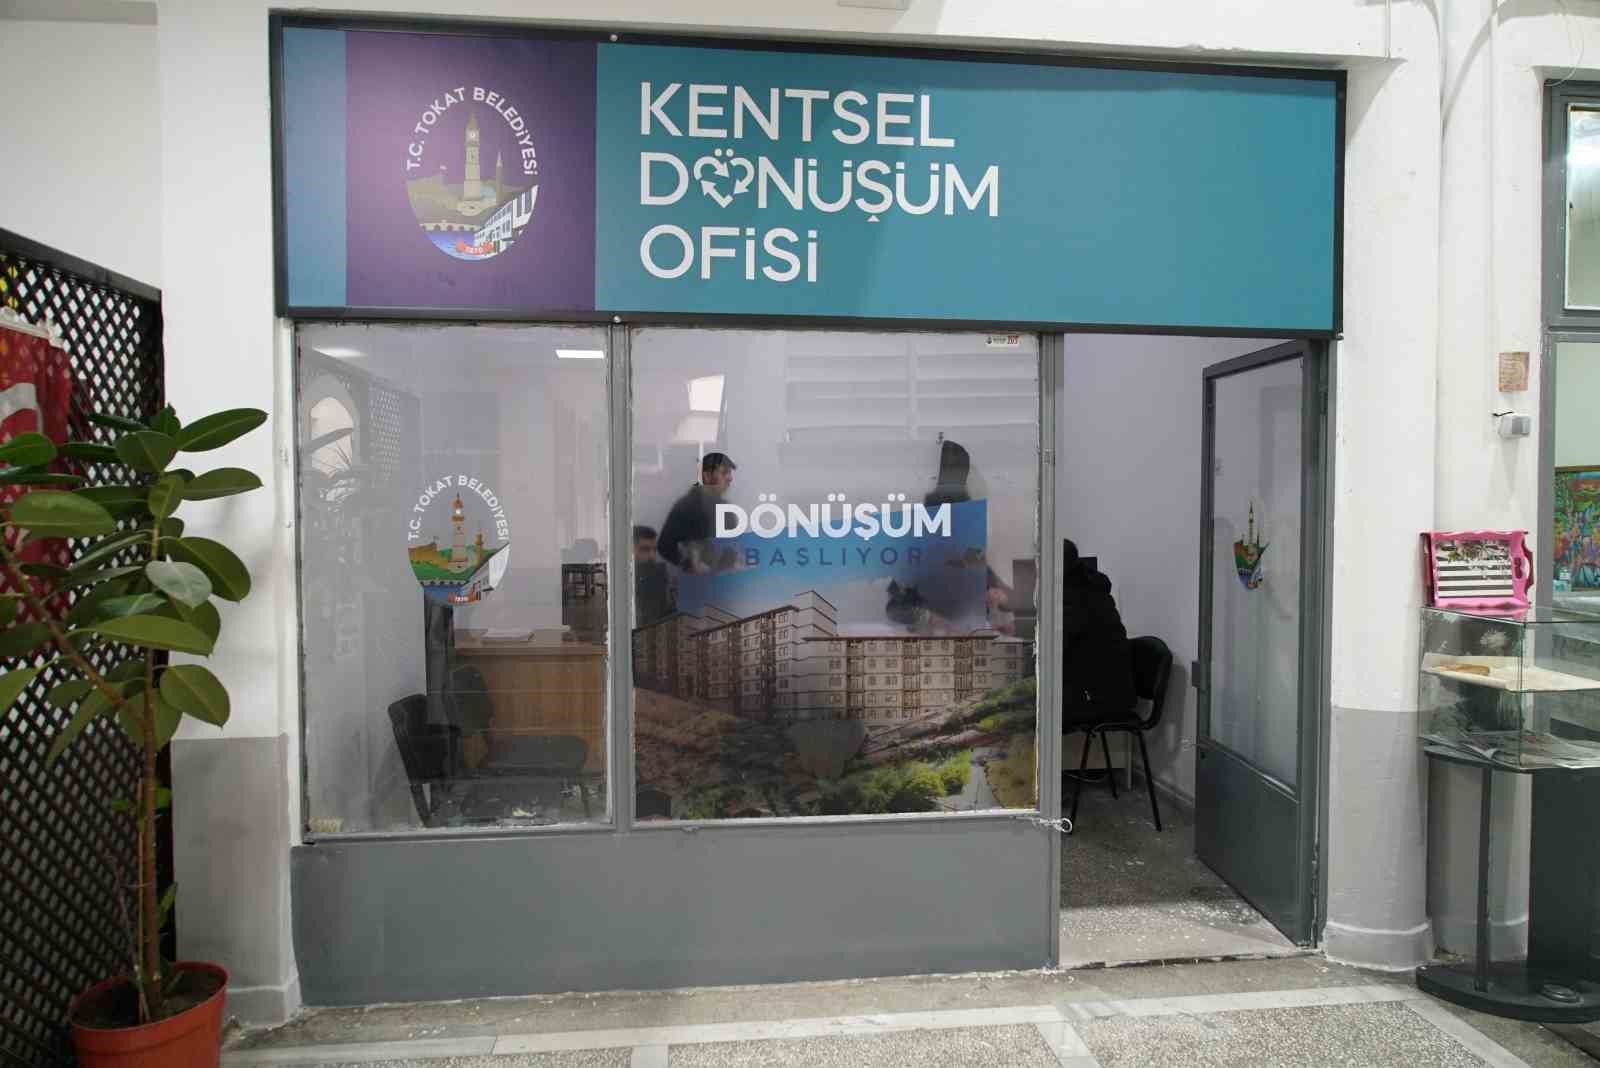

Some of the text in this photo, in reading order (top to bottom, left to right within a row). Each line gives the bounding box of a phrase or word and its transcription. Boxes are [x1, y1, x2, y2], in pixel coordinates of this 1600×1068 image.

[414, 87, 466, 134] TOKAT
[639, 81, 955, 148] KENTSEL
[406, 140, 426, 171] T.C.
[414, 475, 453, 513] TOKAT
[715, 492, 951, 540] DÖNÜŞÜM
